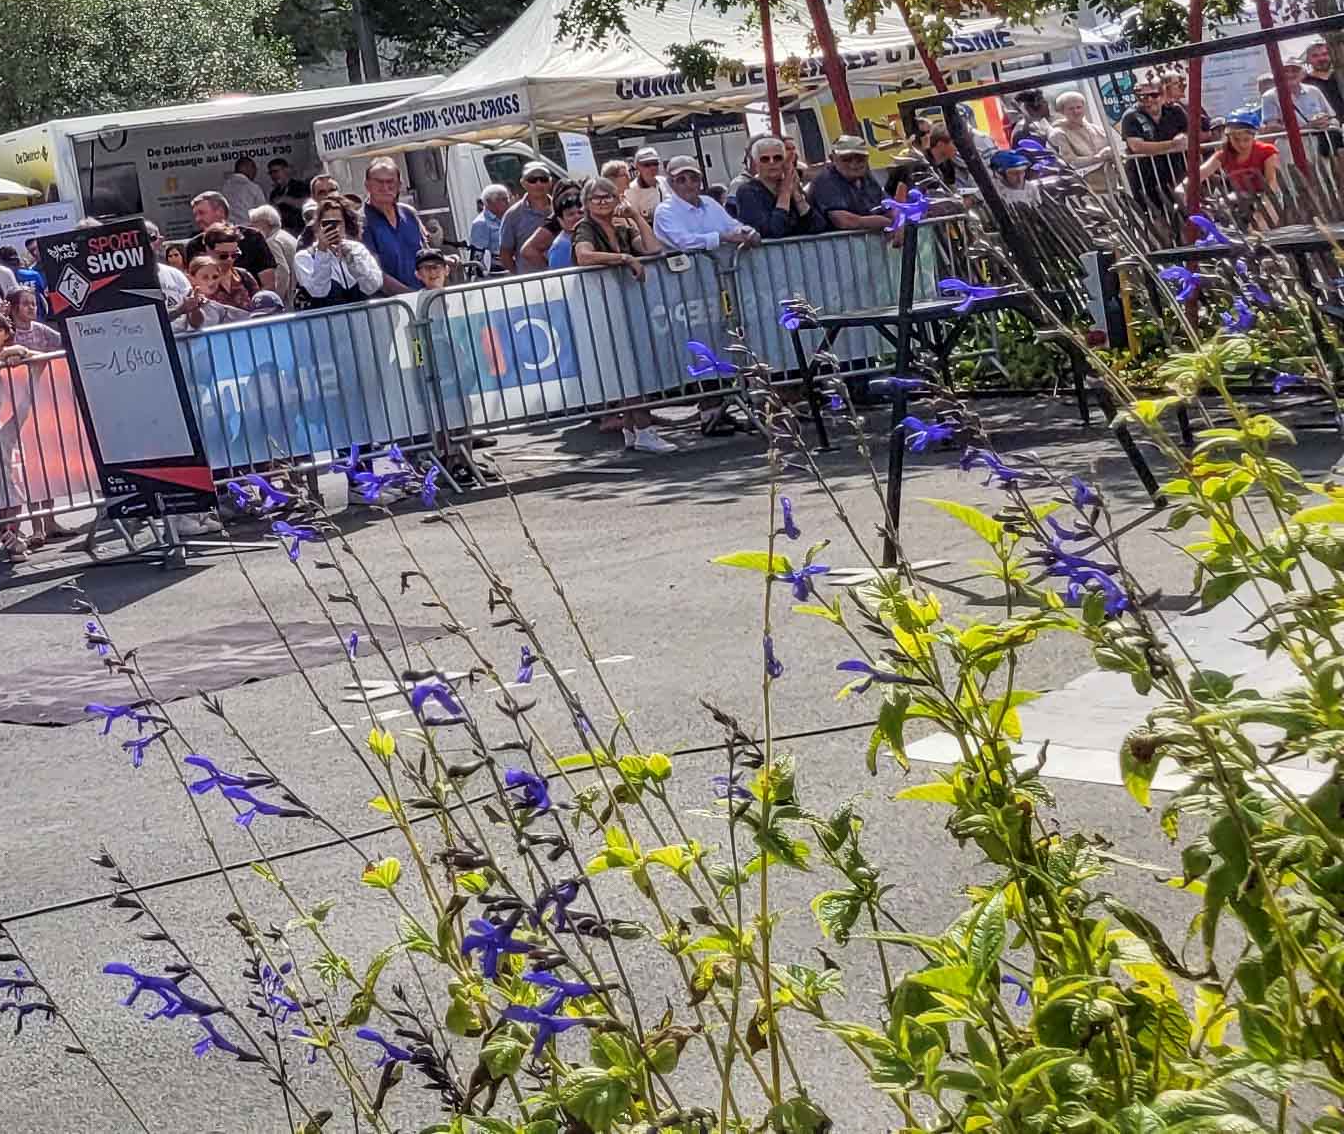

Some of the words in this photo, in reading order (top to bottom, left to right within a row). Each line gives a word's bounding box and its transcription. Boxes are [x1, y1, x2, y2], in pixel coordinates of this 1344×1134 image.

[322, 129, 355, 151] ROUTE
[380, 116, 410, 139] PISTE
[413, 109, 439, 132] BMX
[440, 93, 521, 126] CYCLO-CROSS
[164, 141, 205, 156] Dietrich
[87, 229, 141, 253] SPORT
[86, 246, 145, 274] SHOW
